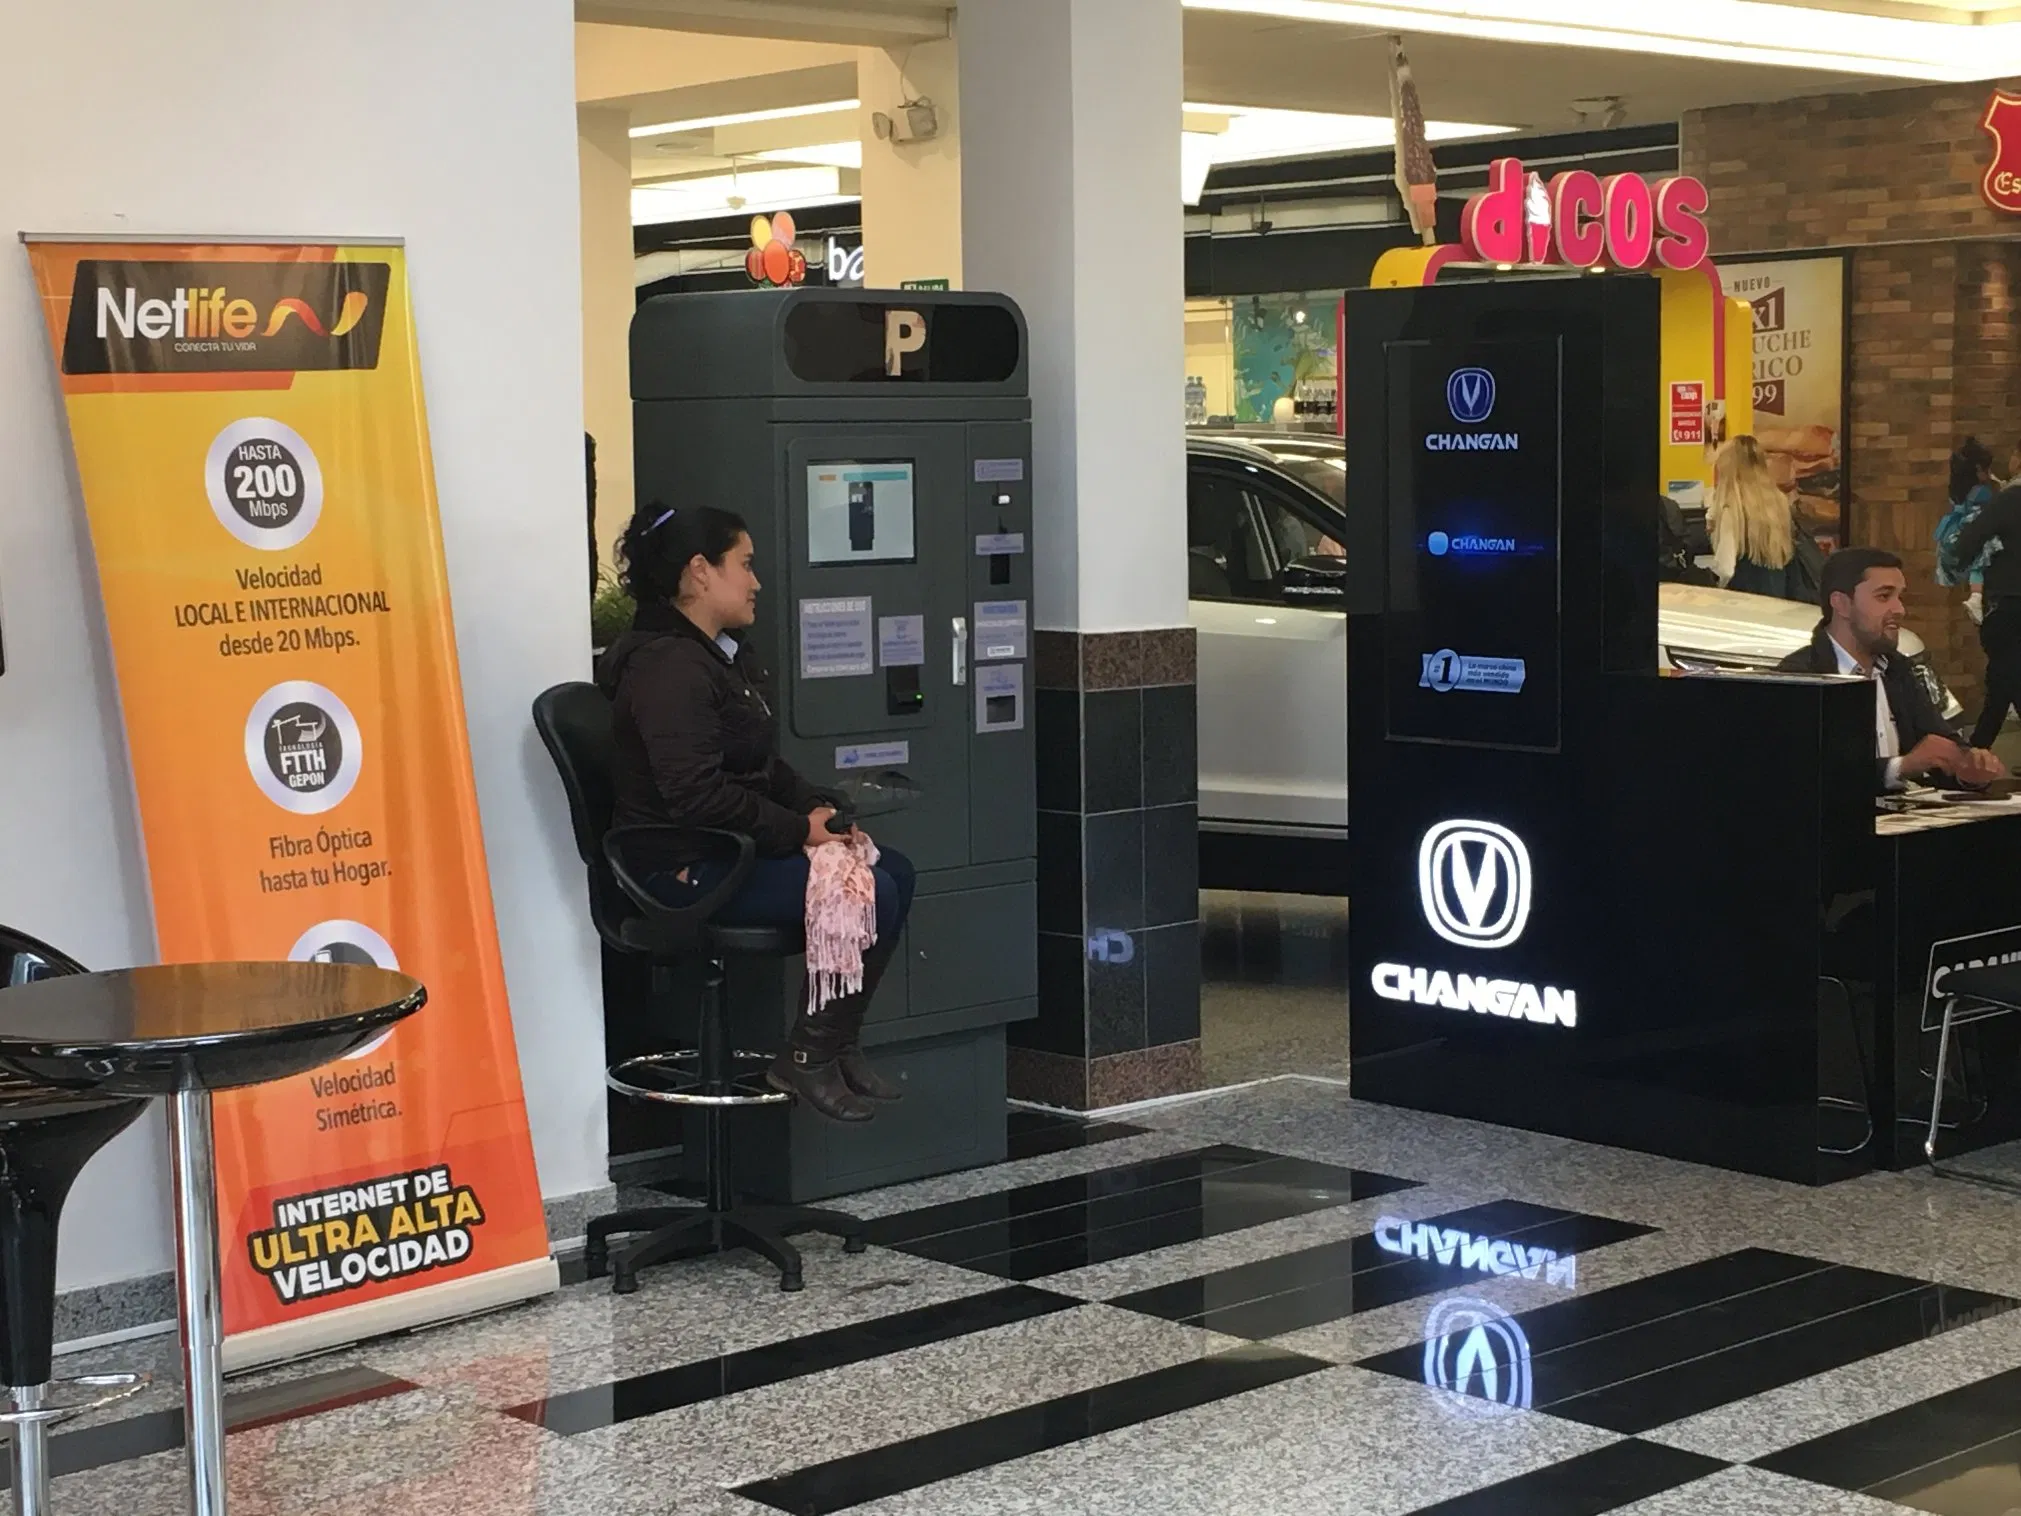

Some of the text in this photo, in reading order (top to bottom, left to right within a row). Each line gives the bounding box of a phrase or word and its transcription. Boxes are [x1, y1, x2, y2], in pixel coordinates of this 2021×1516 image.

[1461, 157, 1709, 270] dicos
[1733, 276, 1771, 293] NUEVO
[97, 287, 258, 339] Netlife
[174, 341, 257, 353] CONECTA TU VIDA
[884, 310, 927, 377] P
[238, 444, 282, 461] HASTA
[1425, 433, 1519, 451] CHANGAN
[233, 463, 297, 499] 200
[249, 500, 289, 520] Mbps
[1451, 537, 1516, 552] CHANGAN
[235, 563, 322, 590] Velocidad
[175, 591, 391, 627] LOCAL E INTERNACIONAL
[219, 626, 360, 657] desde 20 Mbps.
[280, 748, 327, 775] FTTH
[289, 772, 325, 788] GEPON
[269, 825, 373, 859] Fibra Óptica
[259, 860, 392, 893] hasta tu Hogar.
[1371, 962, 1577, 1028] CHANGAN
[310, 1062, 396, 1099] Velocidad
[316, 1100, 402, 1132] Simétrica.
[278, 1169, 449, 1228] INTERNET DE
[252, 1190, 482, 1269] ULTRA ALTA
[272, 1228, 470, 1300] VELOCIDAD
